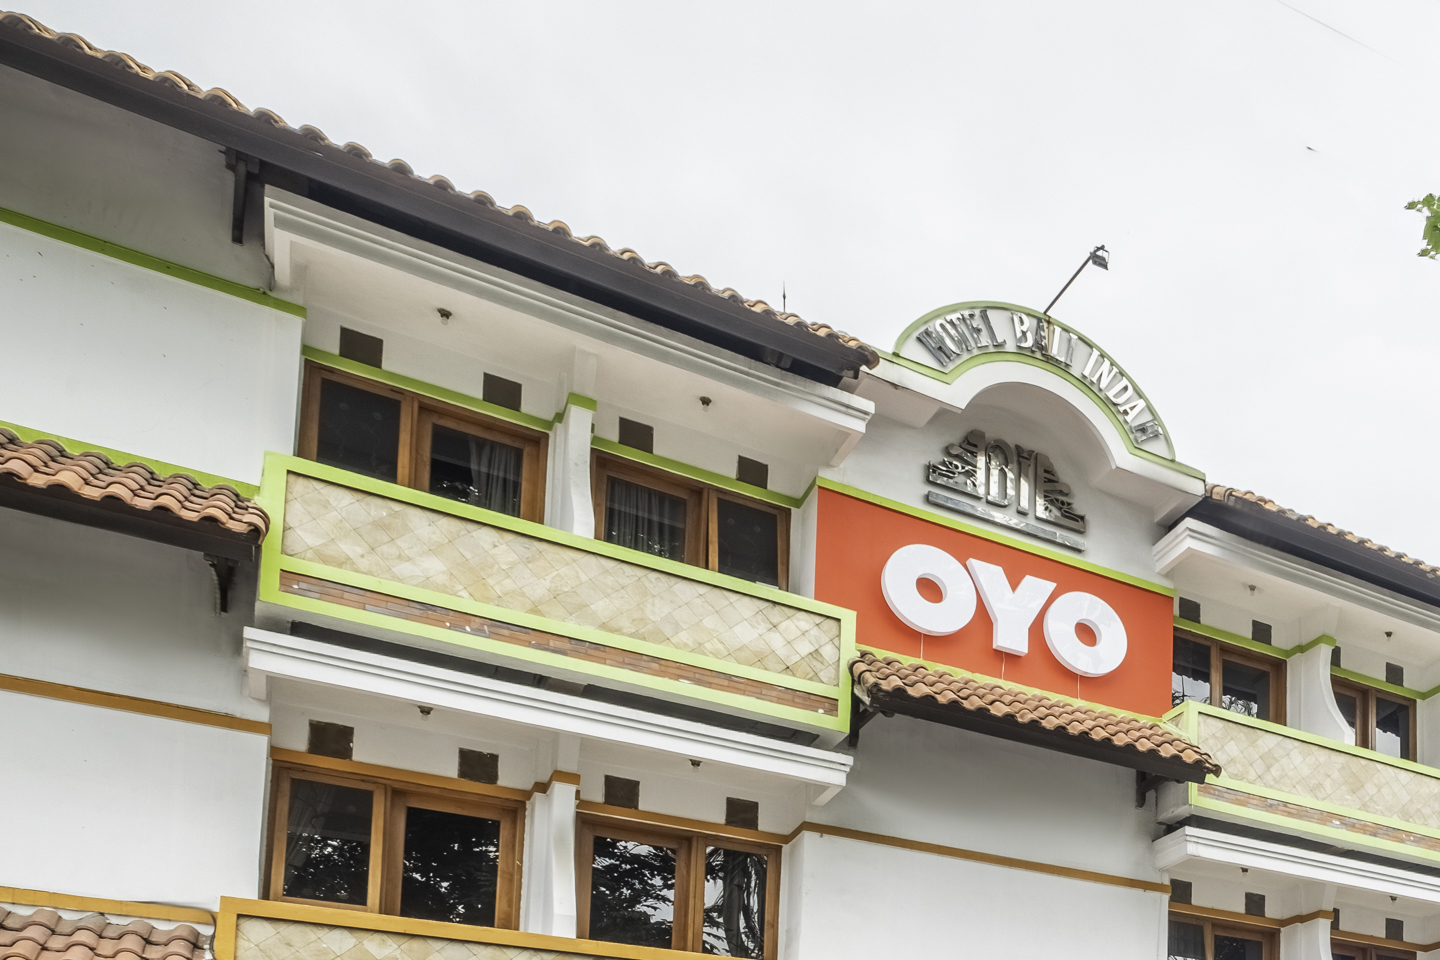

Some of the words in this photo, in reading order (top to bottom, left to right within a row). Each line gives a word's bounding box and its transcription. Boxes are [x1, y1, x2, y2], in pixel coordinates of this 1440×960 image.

[917, 309, 1006, 367] HOTEL
[1011, 311, 1079, 367] BALI
[1082, 348, 1163, 443] INDAH
[881, 544, 1128, 678] OYO
